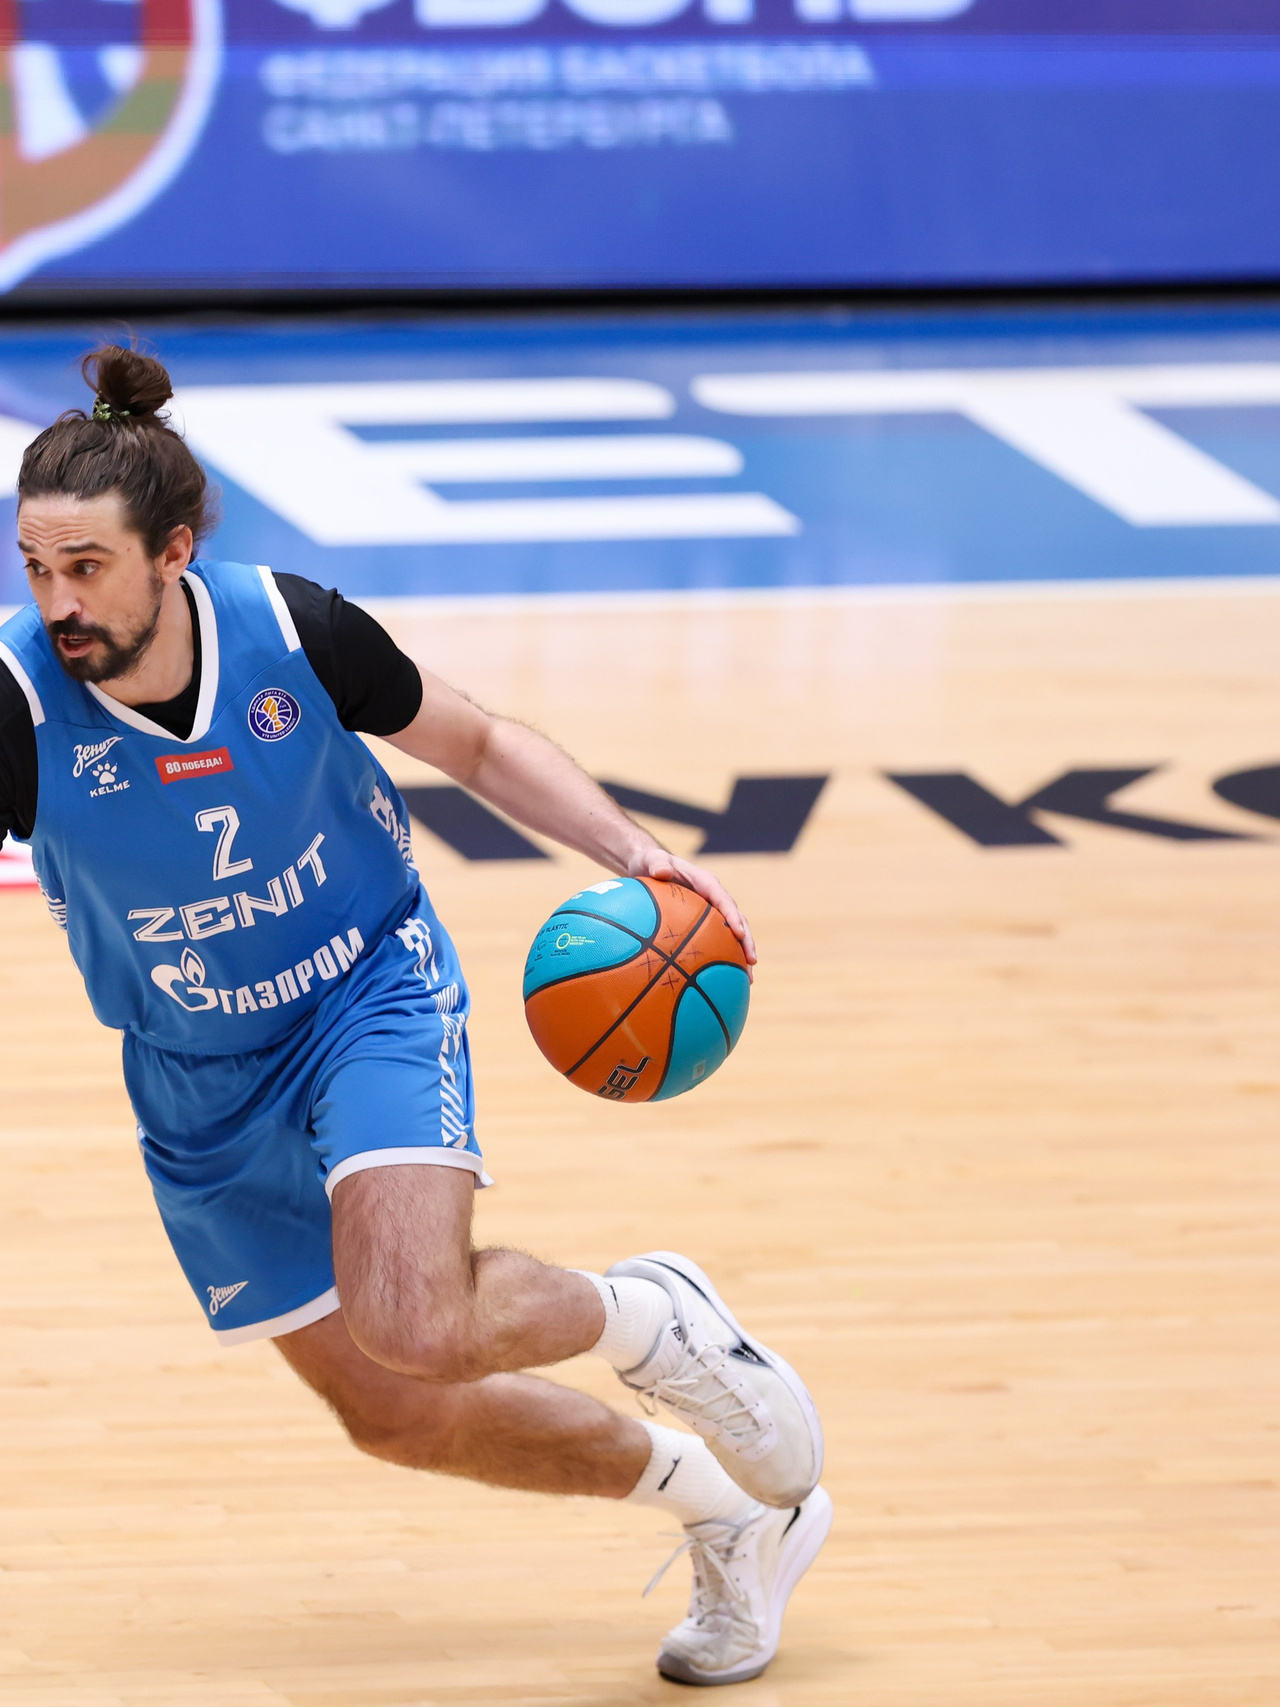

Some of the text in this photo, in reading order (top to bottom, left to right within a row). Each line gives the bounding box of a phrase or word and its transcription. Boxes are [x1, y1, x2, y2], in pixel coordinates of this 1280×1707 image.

[89, 779, 131, 798] KELME
[165, 756, 223, 775] 80 ПОБЕДА!
[194, 804, 254, 882] 2
[126, 831, 328, 943] ZENIT
[218, 926, 366, 1015] ГАЗПРОМ
